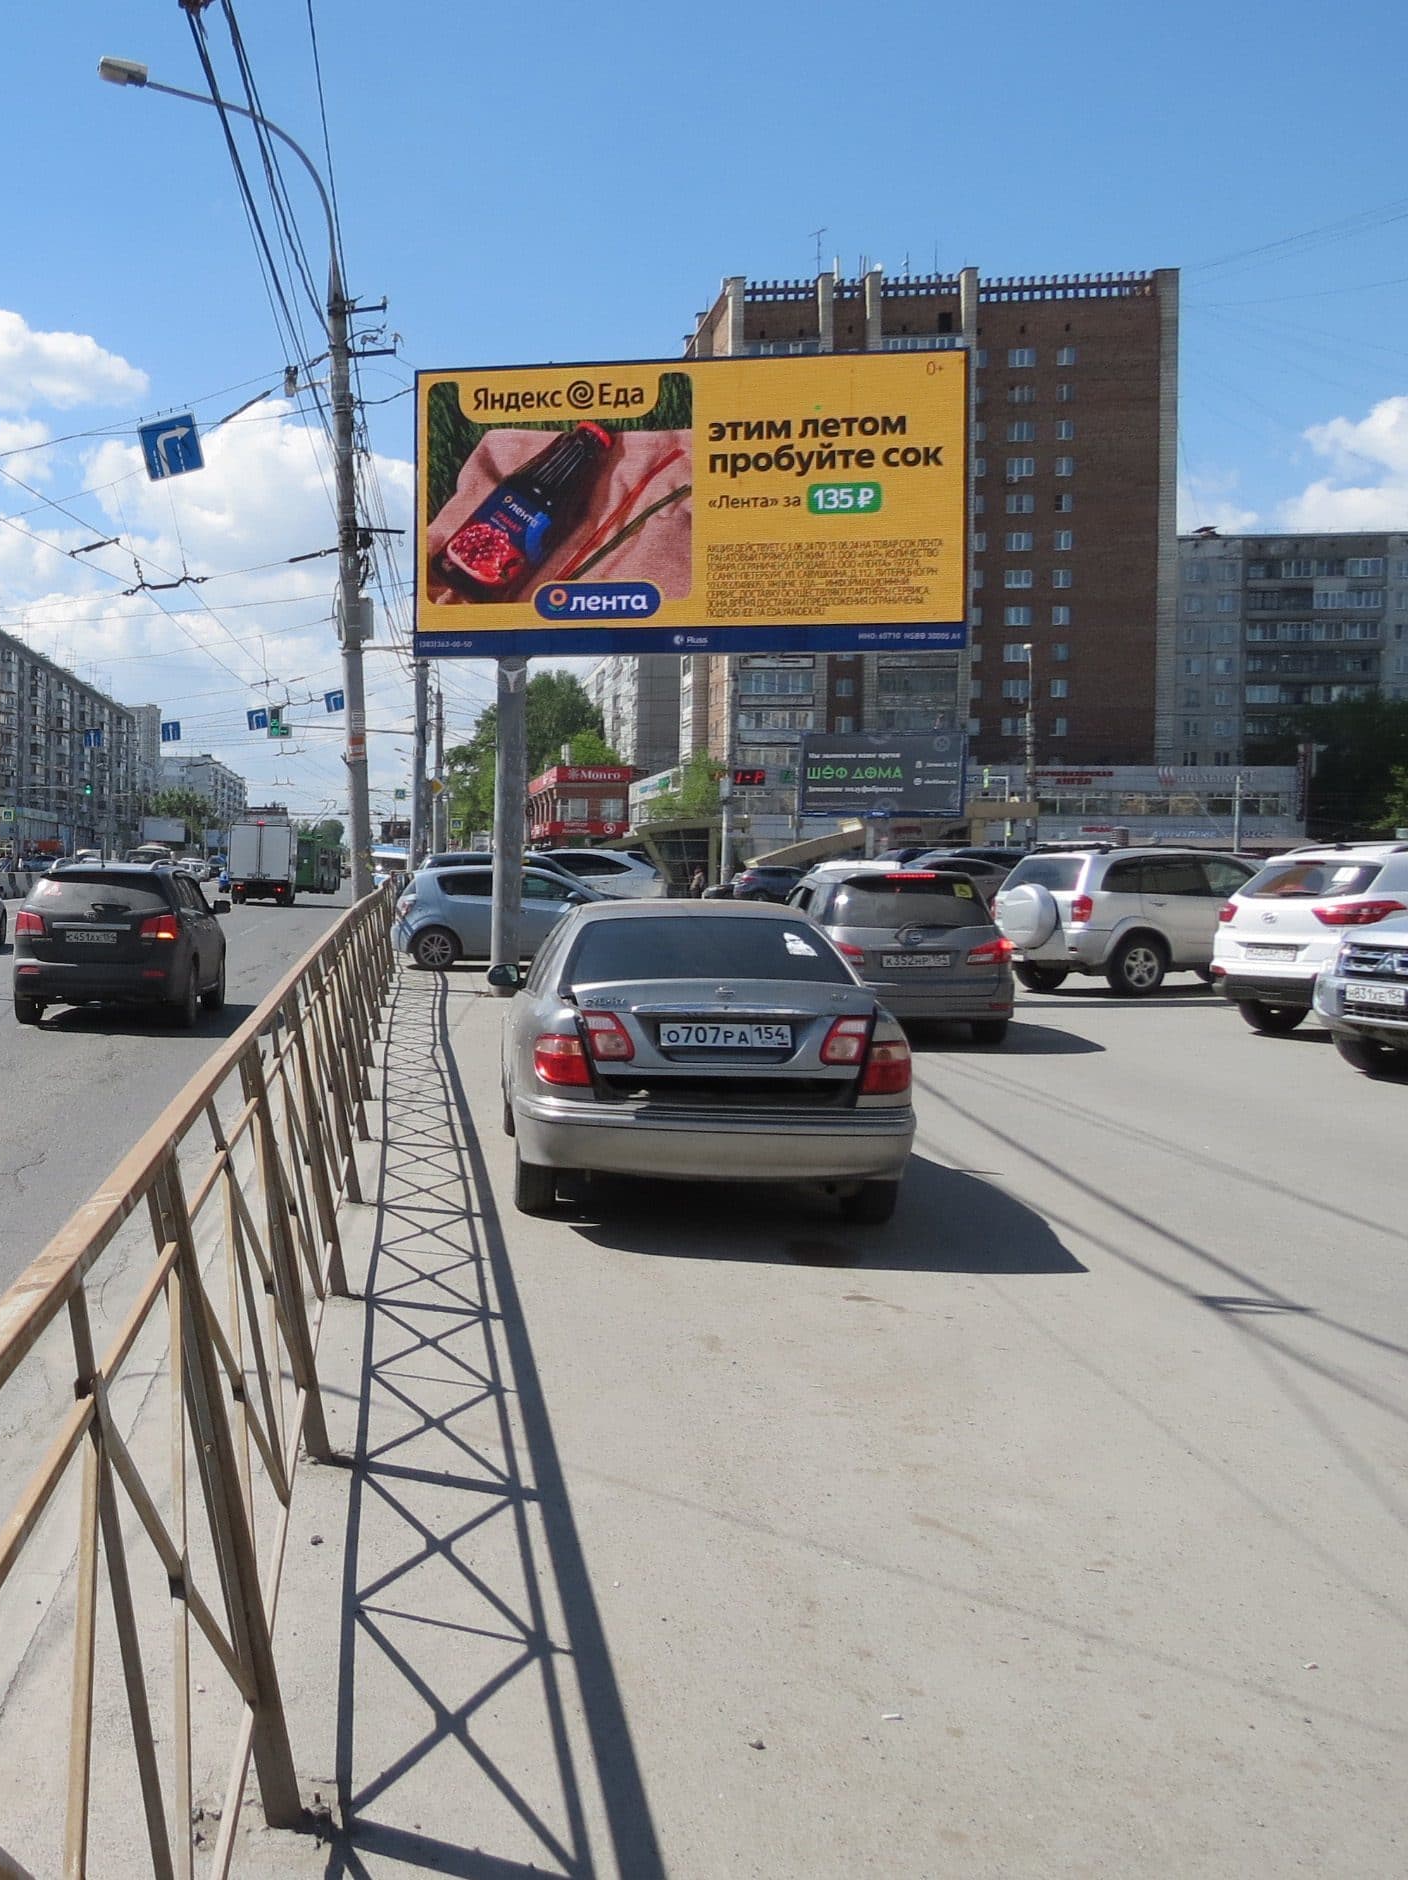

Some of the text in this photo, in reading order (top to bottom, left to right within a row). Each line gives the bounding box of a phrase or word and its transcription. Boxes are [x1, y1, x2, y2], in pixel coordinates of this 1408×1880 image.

[926, 361, 944, 376] 0+
[473, 383, 644, 412] Яндекс Еда
[708, 415, 907, 442] этим летом
[708, 443, 944, 478] пробуйте сок
[708, 494, 801, 510] «Лента» за
[813, 488, 853, 510] 135
[509, 501, 540, 528] лента
[569, 593, 649, 612] лента
[580, 769, 621, 779] Monro
[851, 765, 905, 779] ДОМА
[667, 1026, 785, 1044] О707РА 154
